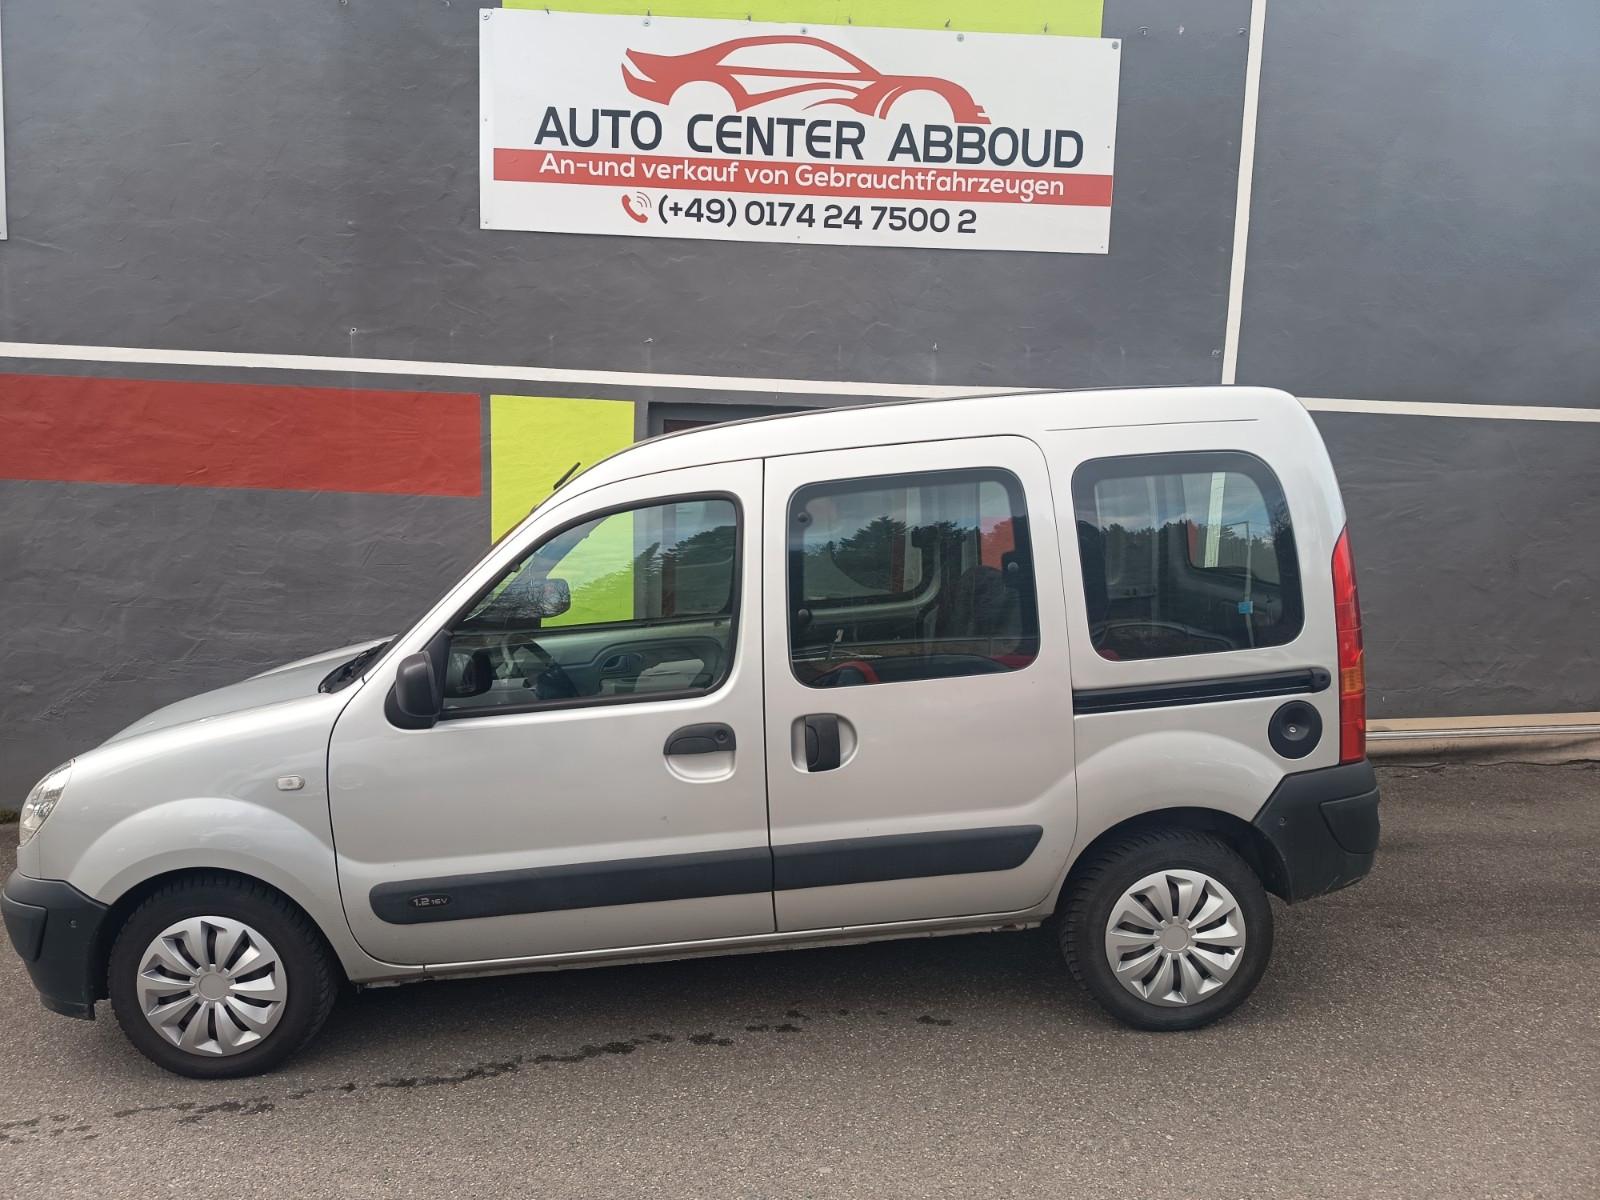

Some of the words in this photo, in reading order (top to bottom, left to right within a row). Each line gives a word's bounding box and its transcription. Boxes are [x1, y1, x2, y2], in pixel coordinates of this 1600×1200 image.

[533, 106, 663, 151] AUTO
[686, 113, 866, 161] CENTER
[887, 123, 1084, 169] ABBOUD
[538, 153, 636, 178] An-und
[641, 159, 740, 183] verkauf
[744, 167, 789, 185] von
[794, 164, 1064, 202] Gebrauchtfahrzeugen
[658, 194, 737, 228] (+49)
[744, 200, 816, 228] 0174
[823, 204, 863, 230] 24
[412, 897, 430, 907] 1.2
